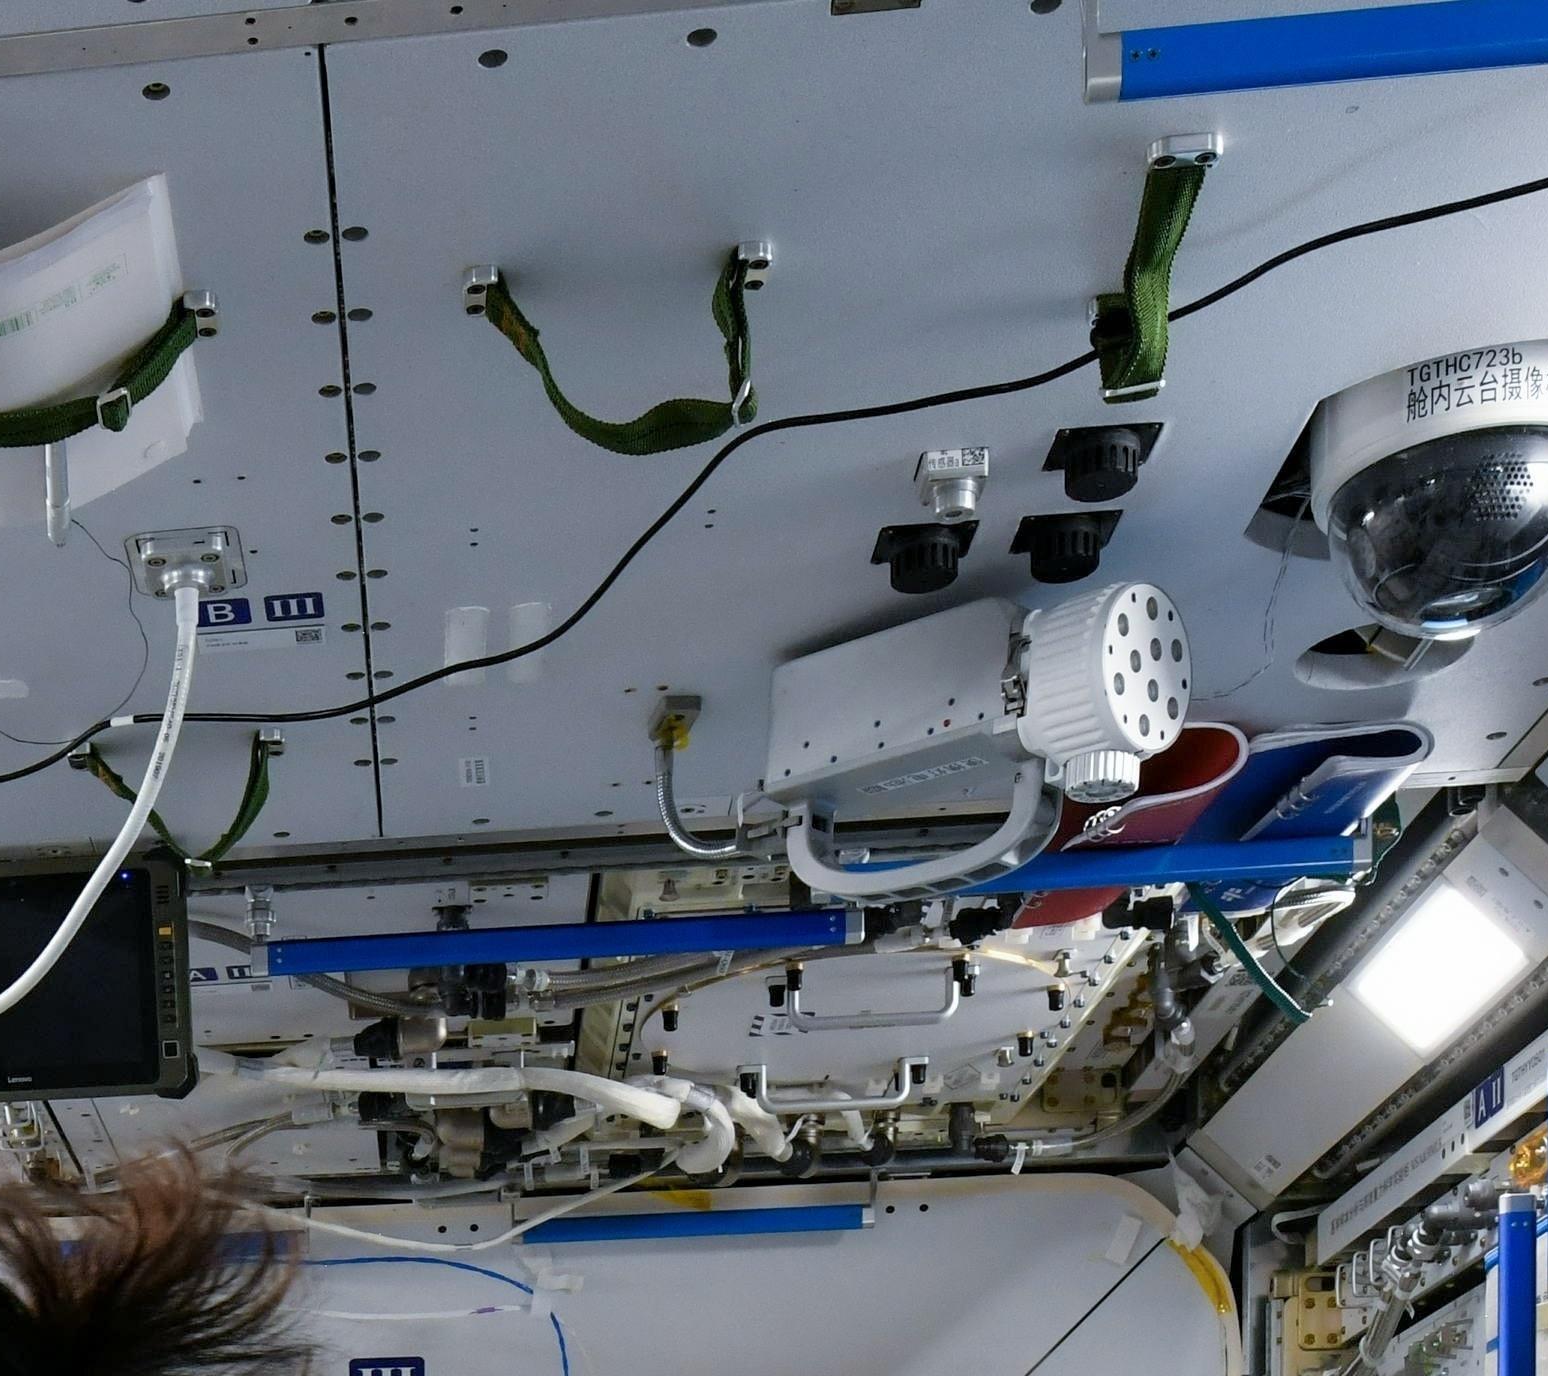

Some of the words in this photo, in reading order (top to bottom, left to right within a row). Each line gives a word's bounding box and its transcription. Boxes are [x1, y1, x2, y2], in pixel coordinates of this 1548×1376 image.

[1406, 348, 1523, 387] TGTHC723b
[207, 603, 235, 622] B
[271, 597, 314, 618] III
